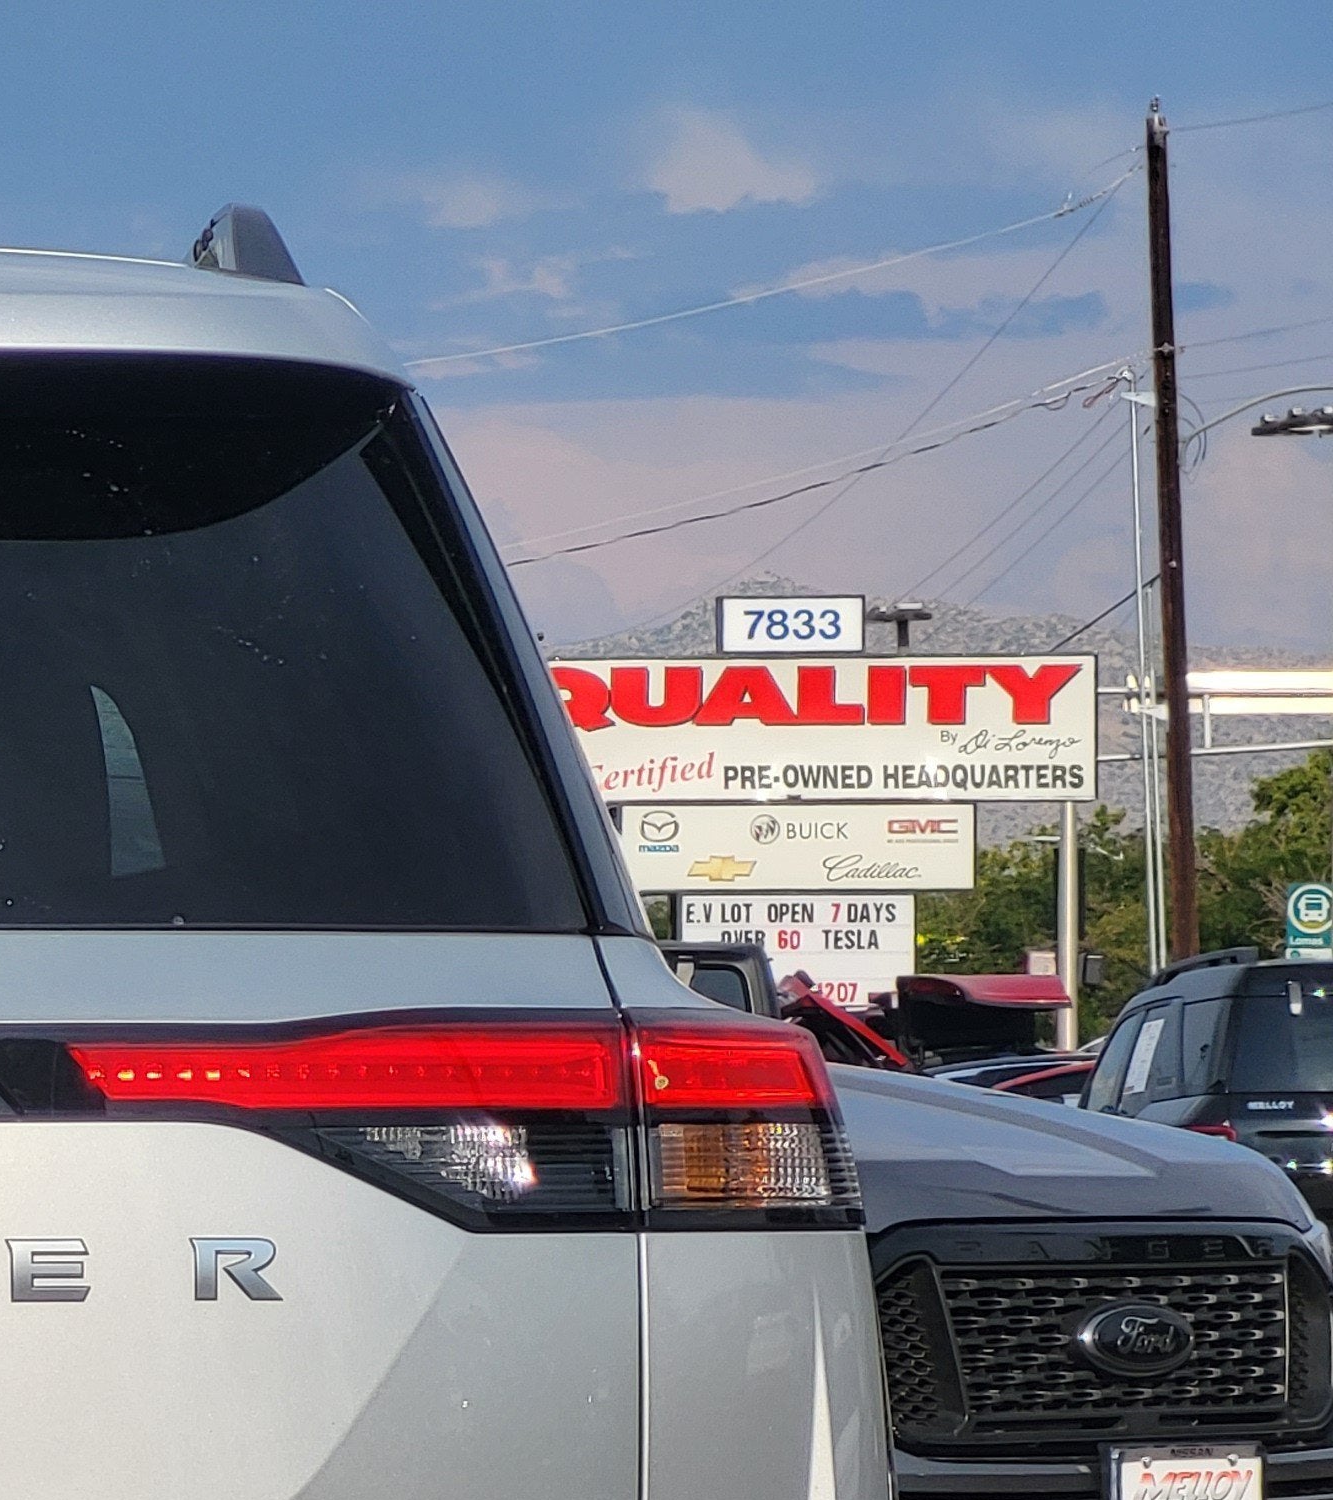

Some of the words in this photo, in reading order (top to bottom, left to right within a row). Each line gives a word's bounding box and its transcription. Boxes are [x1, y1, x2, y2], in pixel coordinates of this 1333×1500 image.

[743, 609, 841, 640] 7833
[550, 664, 1083, 732] QUALITY
[940, 730, 958, 745] By
[723, 764, 873, 789] PRE-OWNED
[883, 764, 1084, 790] HEADQUARTERS
[786, 822, 848, 840] BUICK
[888, 819, 958, 834] GMC
[822, 854, 920, 882] Cadillac
[721, 903, 753, 923] LOT
[767, 903, 814, 923] OPEN
[831, 903, 841, 923] 7
[847, 903, 896, 923] DAYS
[777, 929, 801, 950] 60
[822, 929, 879, 950] TESLA
[1116, 1316, 1176, 1353] Ford
